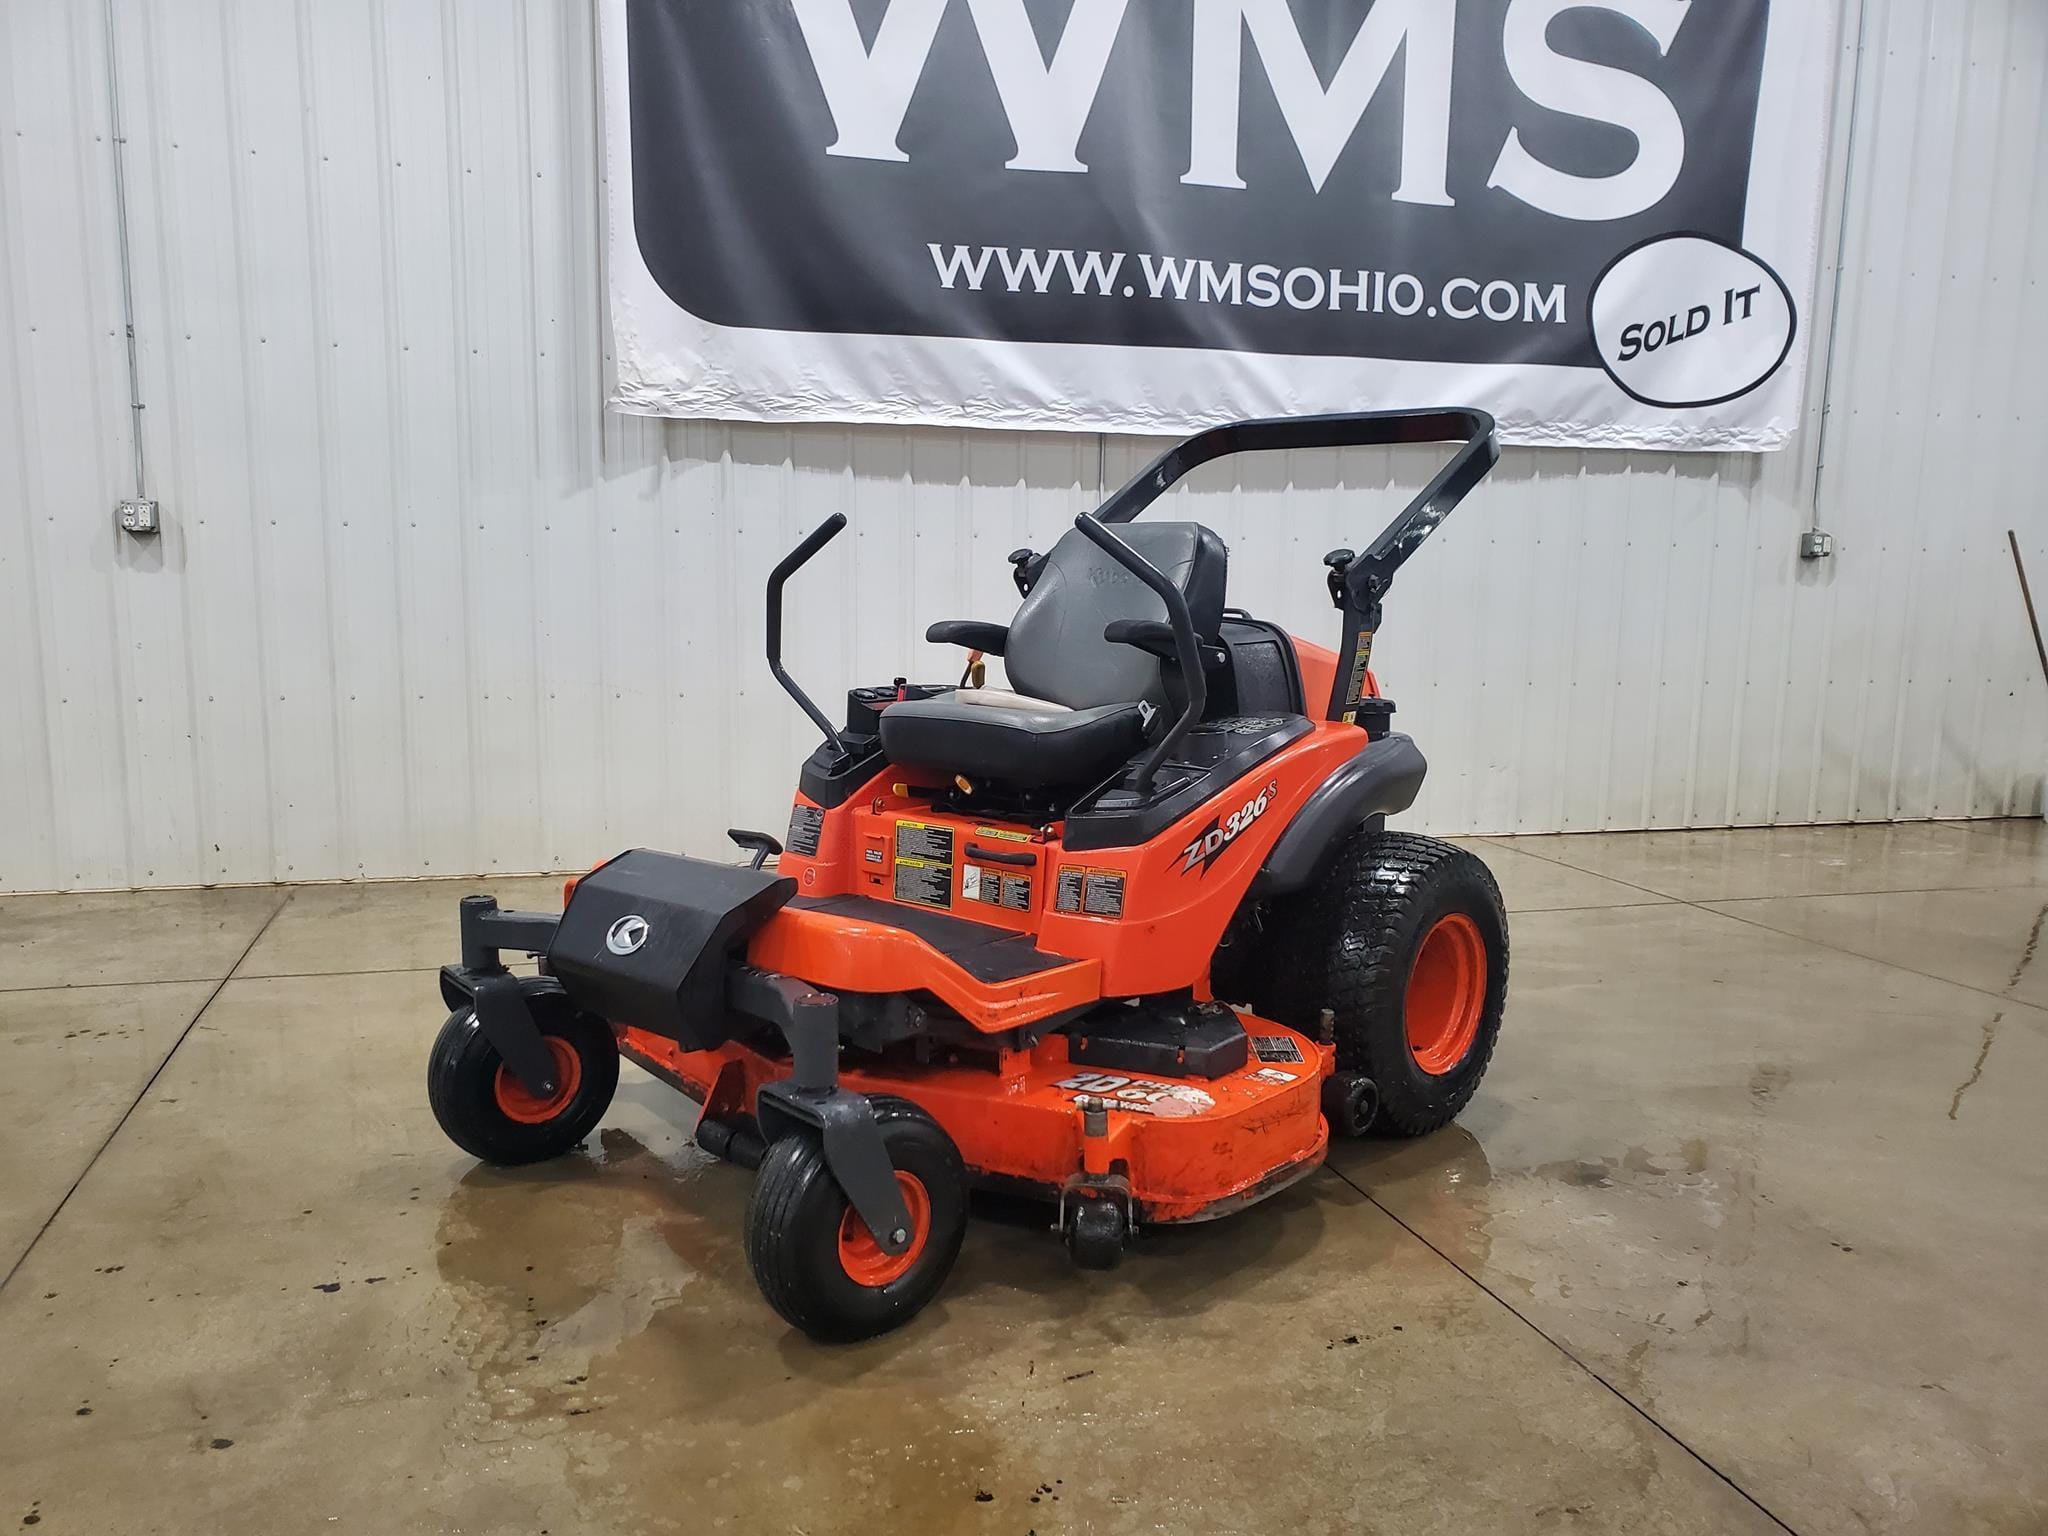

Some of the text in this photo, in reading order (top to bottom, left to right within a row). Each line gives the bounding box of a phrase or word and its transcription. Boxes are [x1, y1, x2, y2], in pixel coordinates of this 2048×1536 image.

[790, 0, 1691, 221] WMS
[927, 243, 1567, 324] WWW.WMSOHIO.COM
[1617, 302, 1711, 362] SOLD
[1054, 1072, 1131, 1093] ZD
